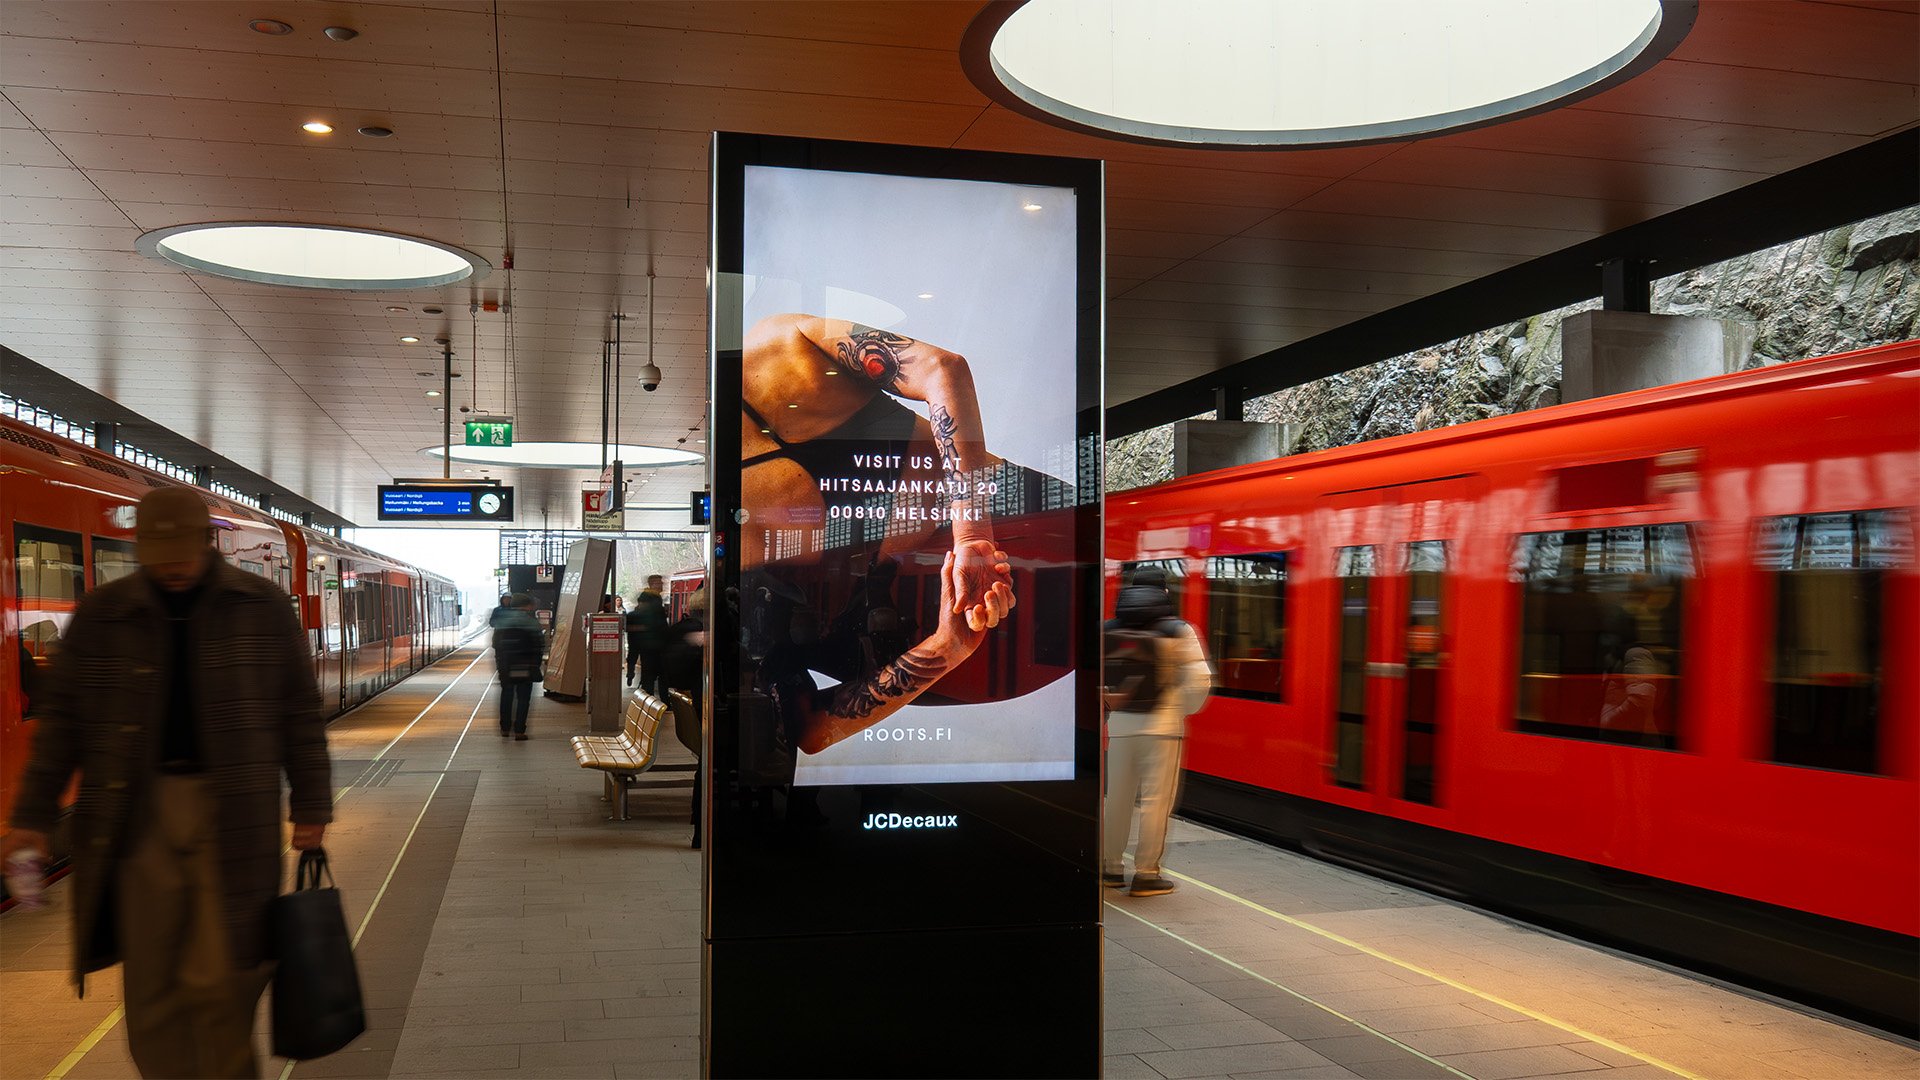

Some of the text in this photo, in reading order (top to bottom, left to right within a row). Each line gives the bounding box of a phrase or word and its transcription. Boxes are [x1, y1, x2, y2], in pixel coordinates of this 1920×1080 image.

[853, 454, 962, 471] VISIT US AT
[819, 478, 998, 495] HITSAAJANKATU 20
[830, 505, 886, 520] 00810
[896, 507, 980, 521] HELSINKI
[864, 728, 952, 742] ROOTS.FI
[863, 812, 958, 830] JCDecaux
